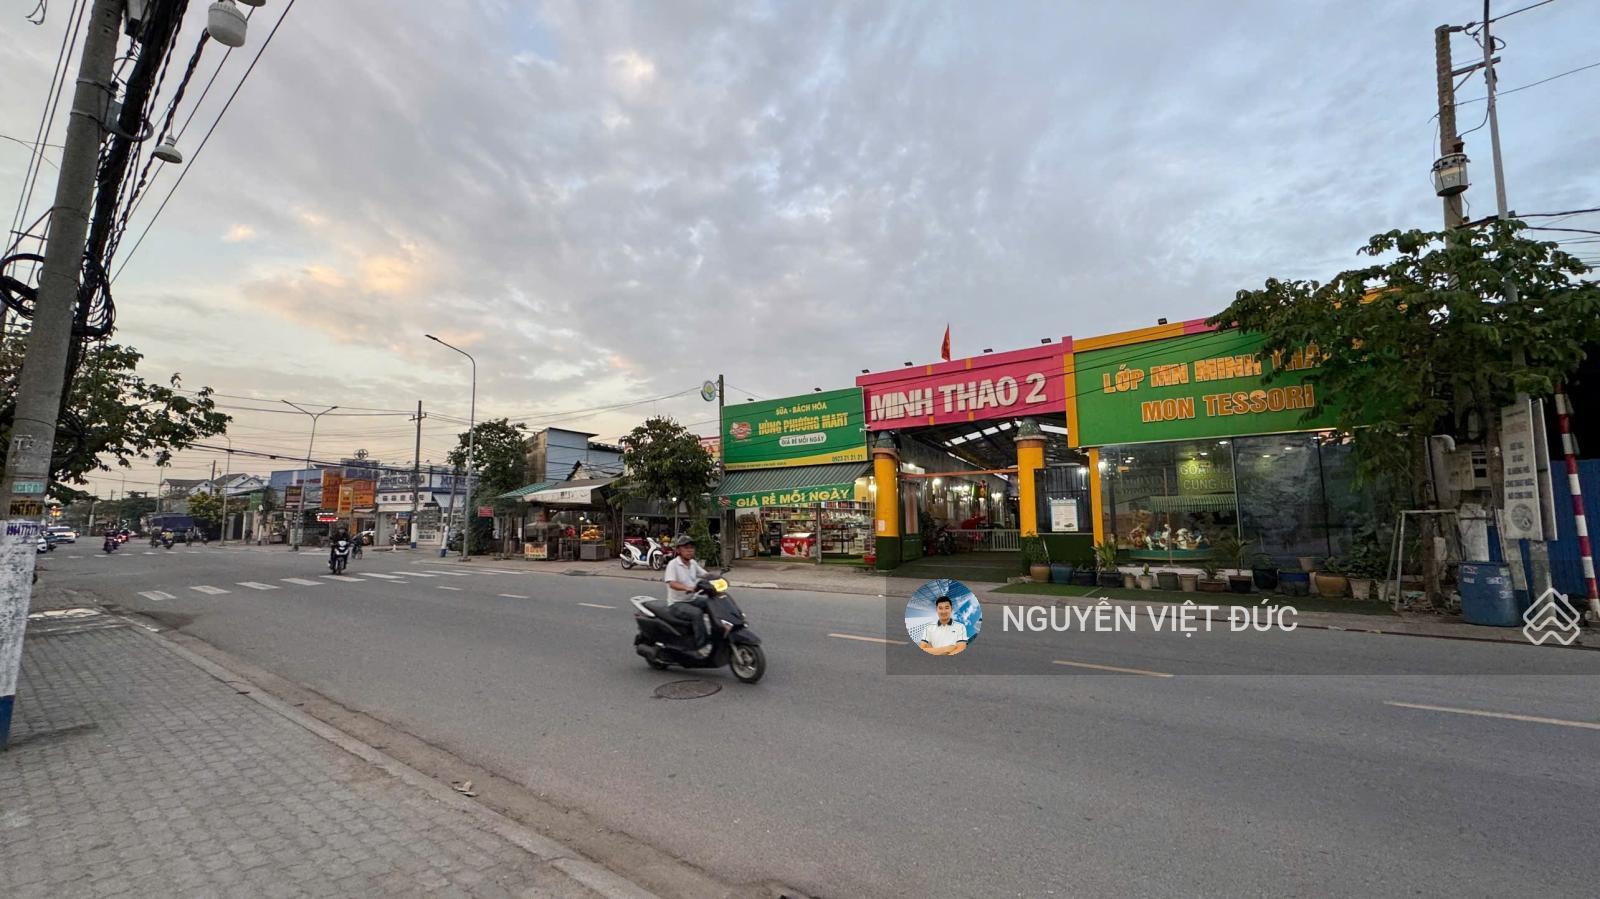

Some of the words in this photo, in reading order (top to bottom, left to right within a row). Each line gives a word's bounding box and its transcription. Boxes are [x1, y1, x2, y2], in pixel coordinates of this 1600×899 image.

[1102, 363, 1145, 394] LỚP
[1150, 363, 1189, 387] MN
[1194, 353, 1262, 382] MINH
[775, 406, 788, 416] SỮA
[792, 403, 811, 414] BÁCH
[812, 401, 827, 410] HÓA
[870, 387, 933, 421] MINH
[939, 376, 1019, 413] THAO
[1025, 373, 1047, 404] 2
[1141, 397, 1196, 423] MON
[1203, 384, 1315, 417] TESSORI
[758, 419, 782, 435] HÙNG
[822, 412, 849, 429] MART
[736, 494, 758, 508] GIÁ
[762, 492, 776, 505] RẺ
[780, 490, 805, 504] MỖI
[809, 488, 849, 501] NGÀY
